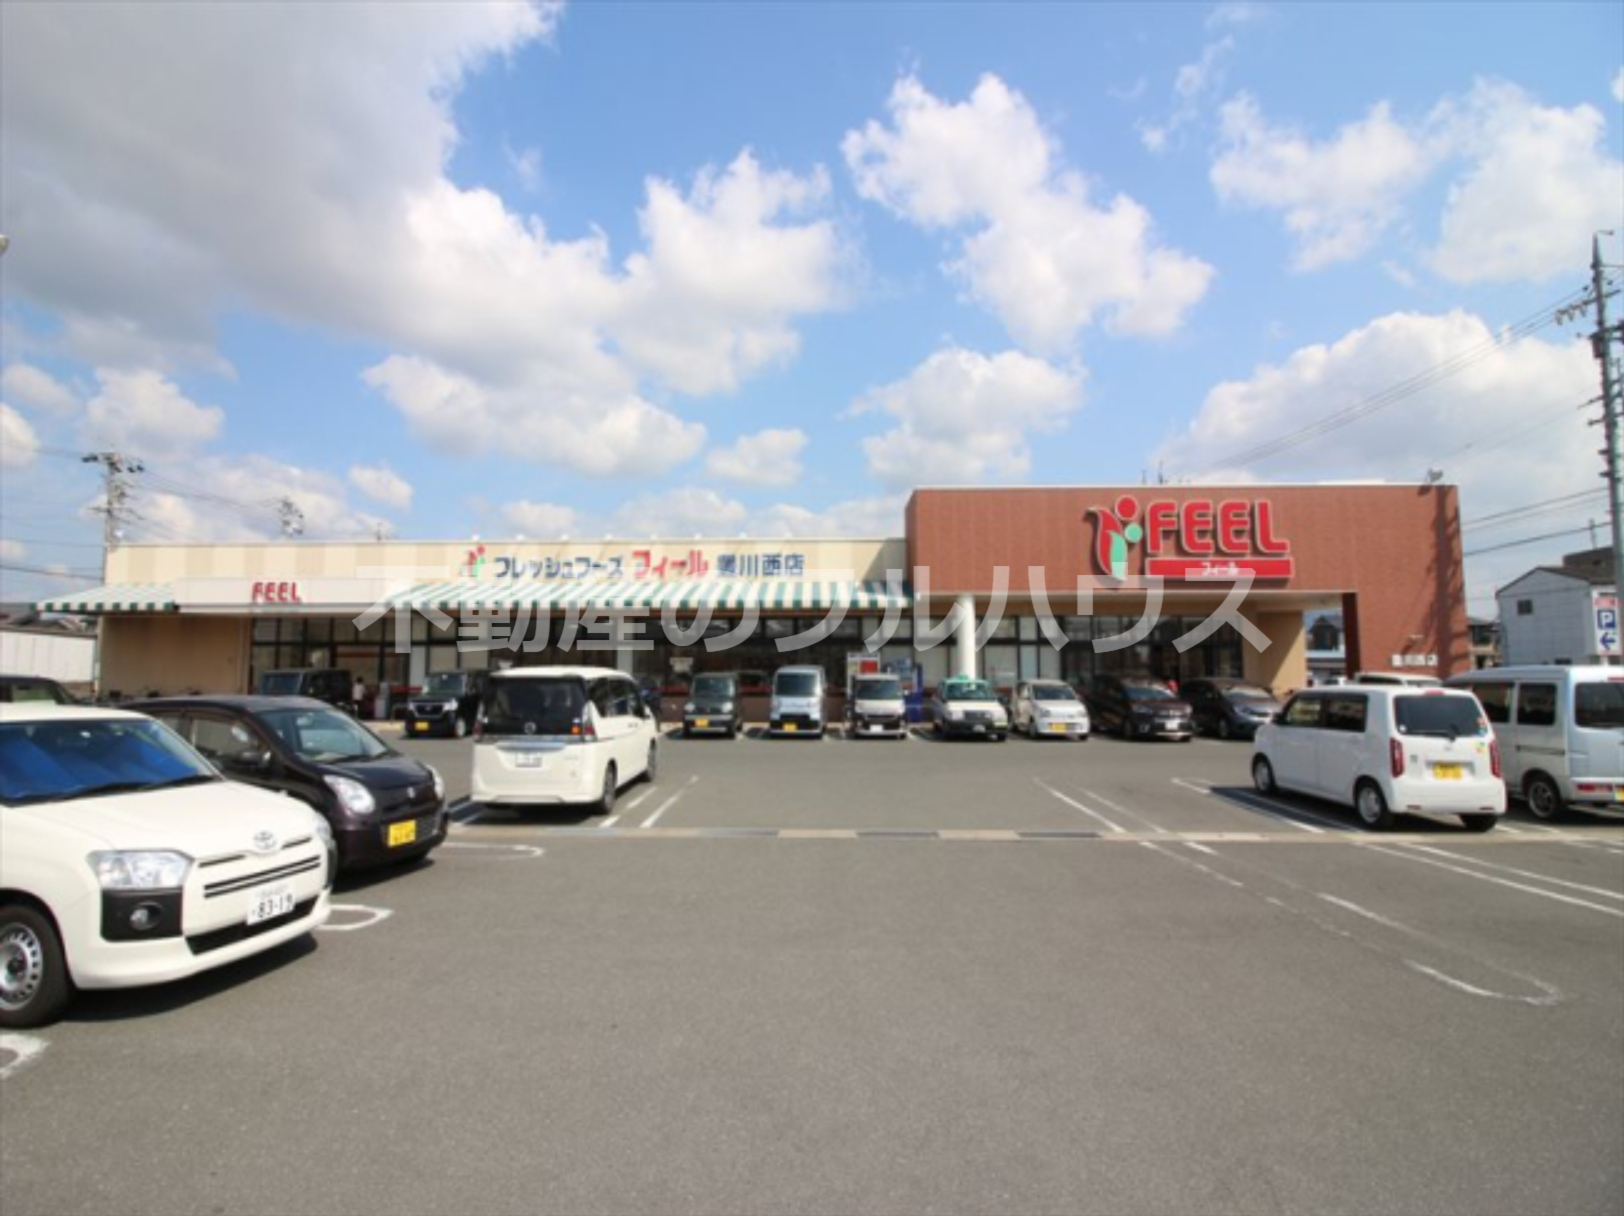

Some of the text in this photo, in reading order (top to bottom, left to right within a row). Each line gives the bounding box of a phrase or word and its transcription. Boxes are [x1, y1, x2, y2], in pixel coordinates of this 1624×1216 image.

[1146, 500, 1291, 554] FEEL
[493, 556, 624, 578] フレッシュフーズ
[632, 550, 708, 578] フィール
[252, 581, 302, 603] FEEL
[1600, 612, 1613, 627] P
[257, 892, 292, 917] 83-19
